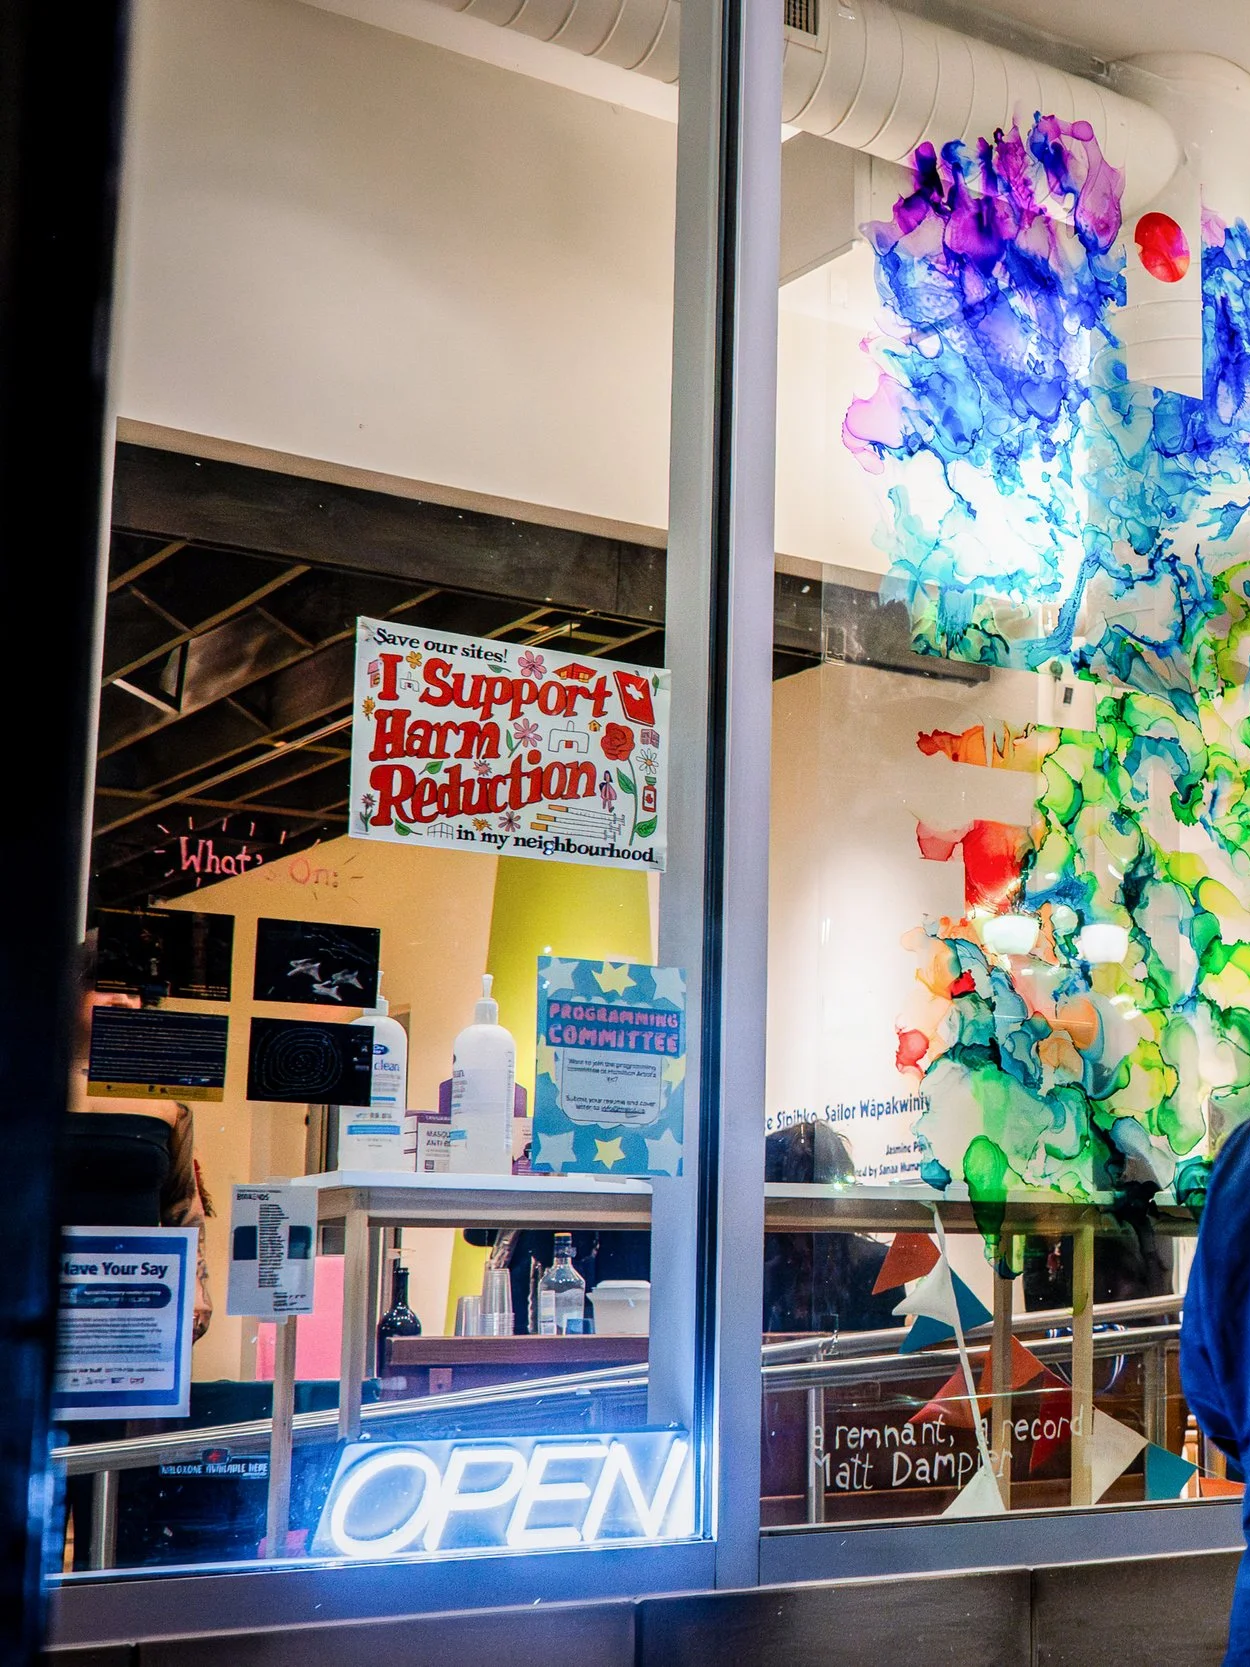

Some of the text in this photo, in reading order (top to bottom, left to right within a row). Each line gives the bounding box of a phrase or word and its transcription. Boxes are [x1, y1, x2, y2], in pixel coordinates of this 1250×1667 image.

[373, 627, 508, 663] Save our sites!
[378, 653, 613, 722] I Support
[368, 708, 501, 762] Harm
[369, 749, 597, 827] Reduction
[456, 824, 660, 864] in my neighbourhood.
[549, 1002, 678, 1028] PROGRAMMING
[548, 1023, 678, 1053] COMMITTEE
[825, 1104, 856, 1122] Sailor
[102, 1262, 138, 1275] Your
[141, 1262, 168, 1279] Say
[835, 1414, 954, 1450] remnant,
[1001, 1404, 1084, 1442] record
[811, 1452, 873, 1490] Matt
[330, 1439, 690, 1557] OPEN
